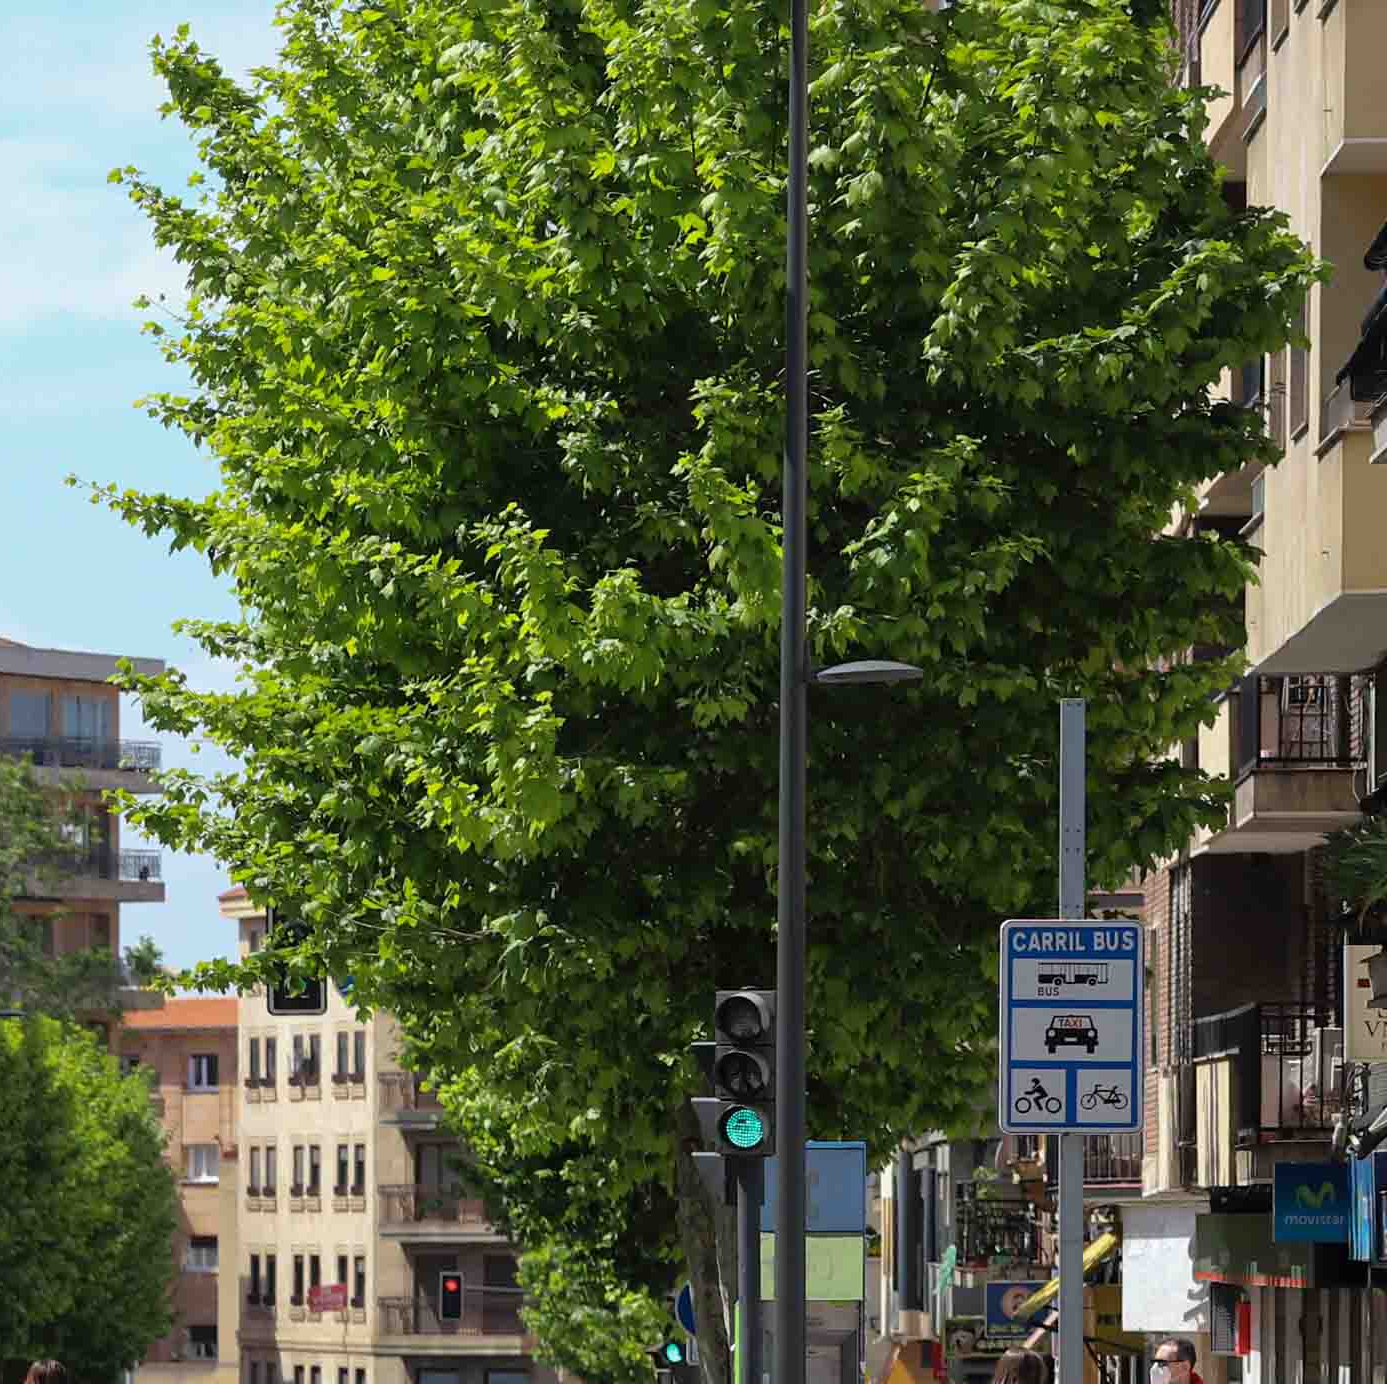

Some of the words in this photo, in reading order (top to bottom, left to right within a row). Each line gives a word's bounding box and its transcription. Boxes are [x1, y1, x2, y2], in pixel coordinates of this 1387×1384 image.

[1012, 931, 1086, 952] CARRIL
[1093, 930, 1134, 952] BUS
[1037, 987, 1060, 997] BUS
[1058, 1018, 1083, 1028] TAXI
